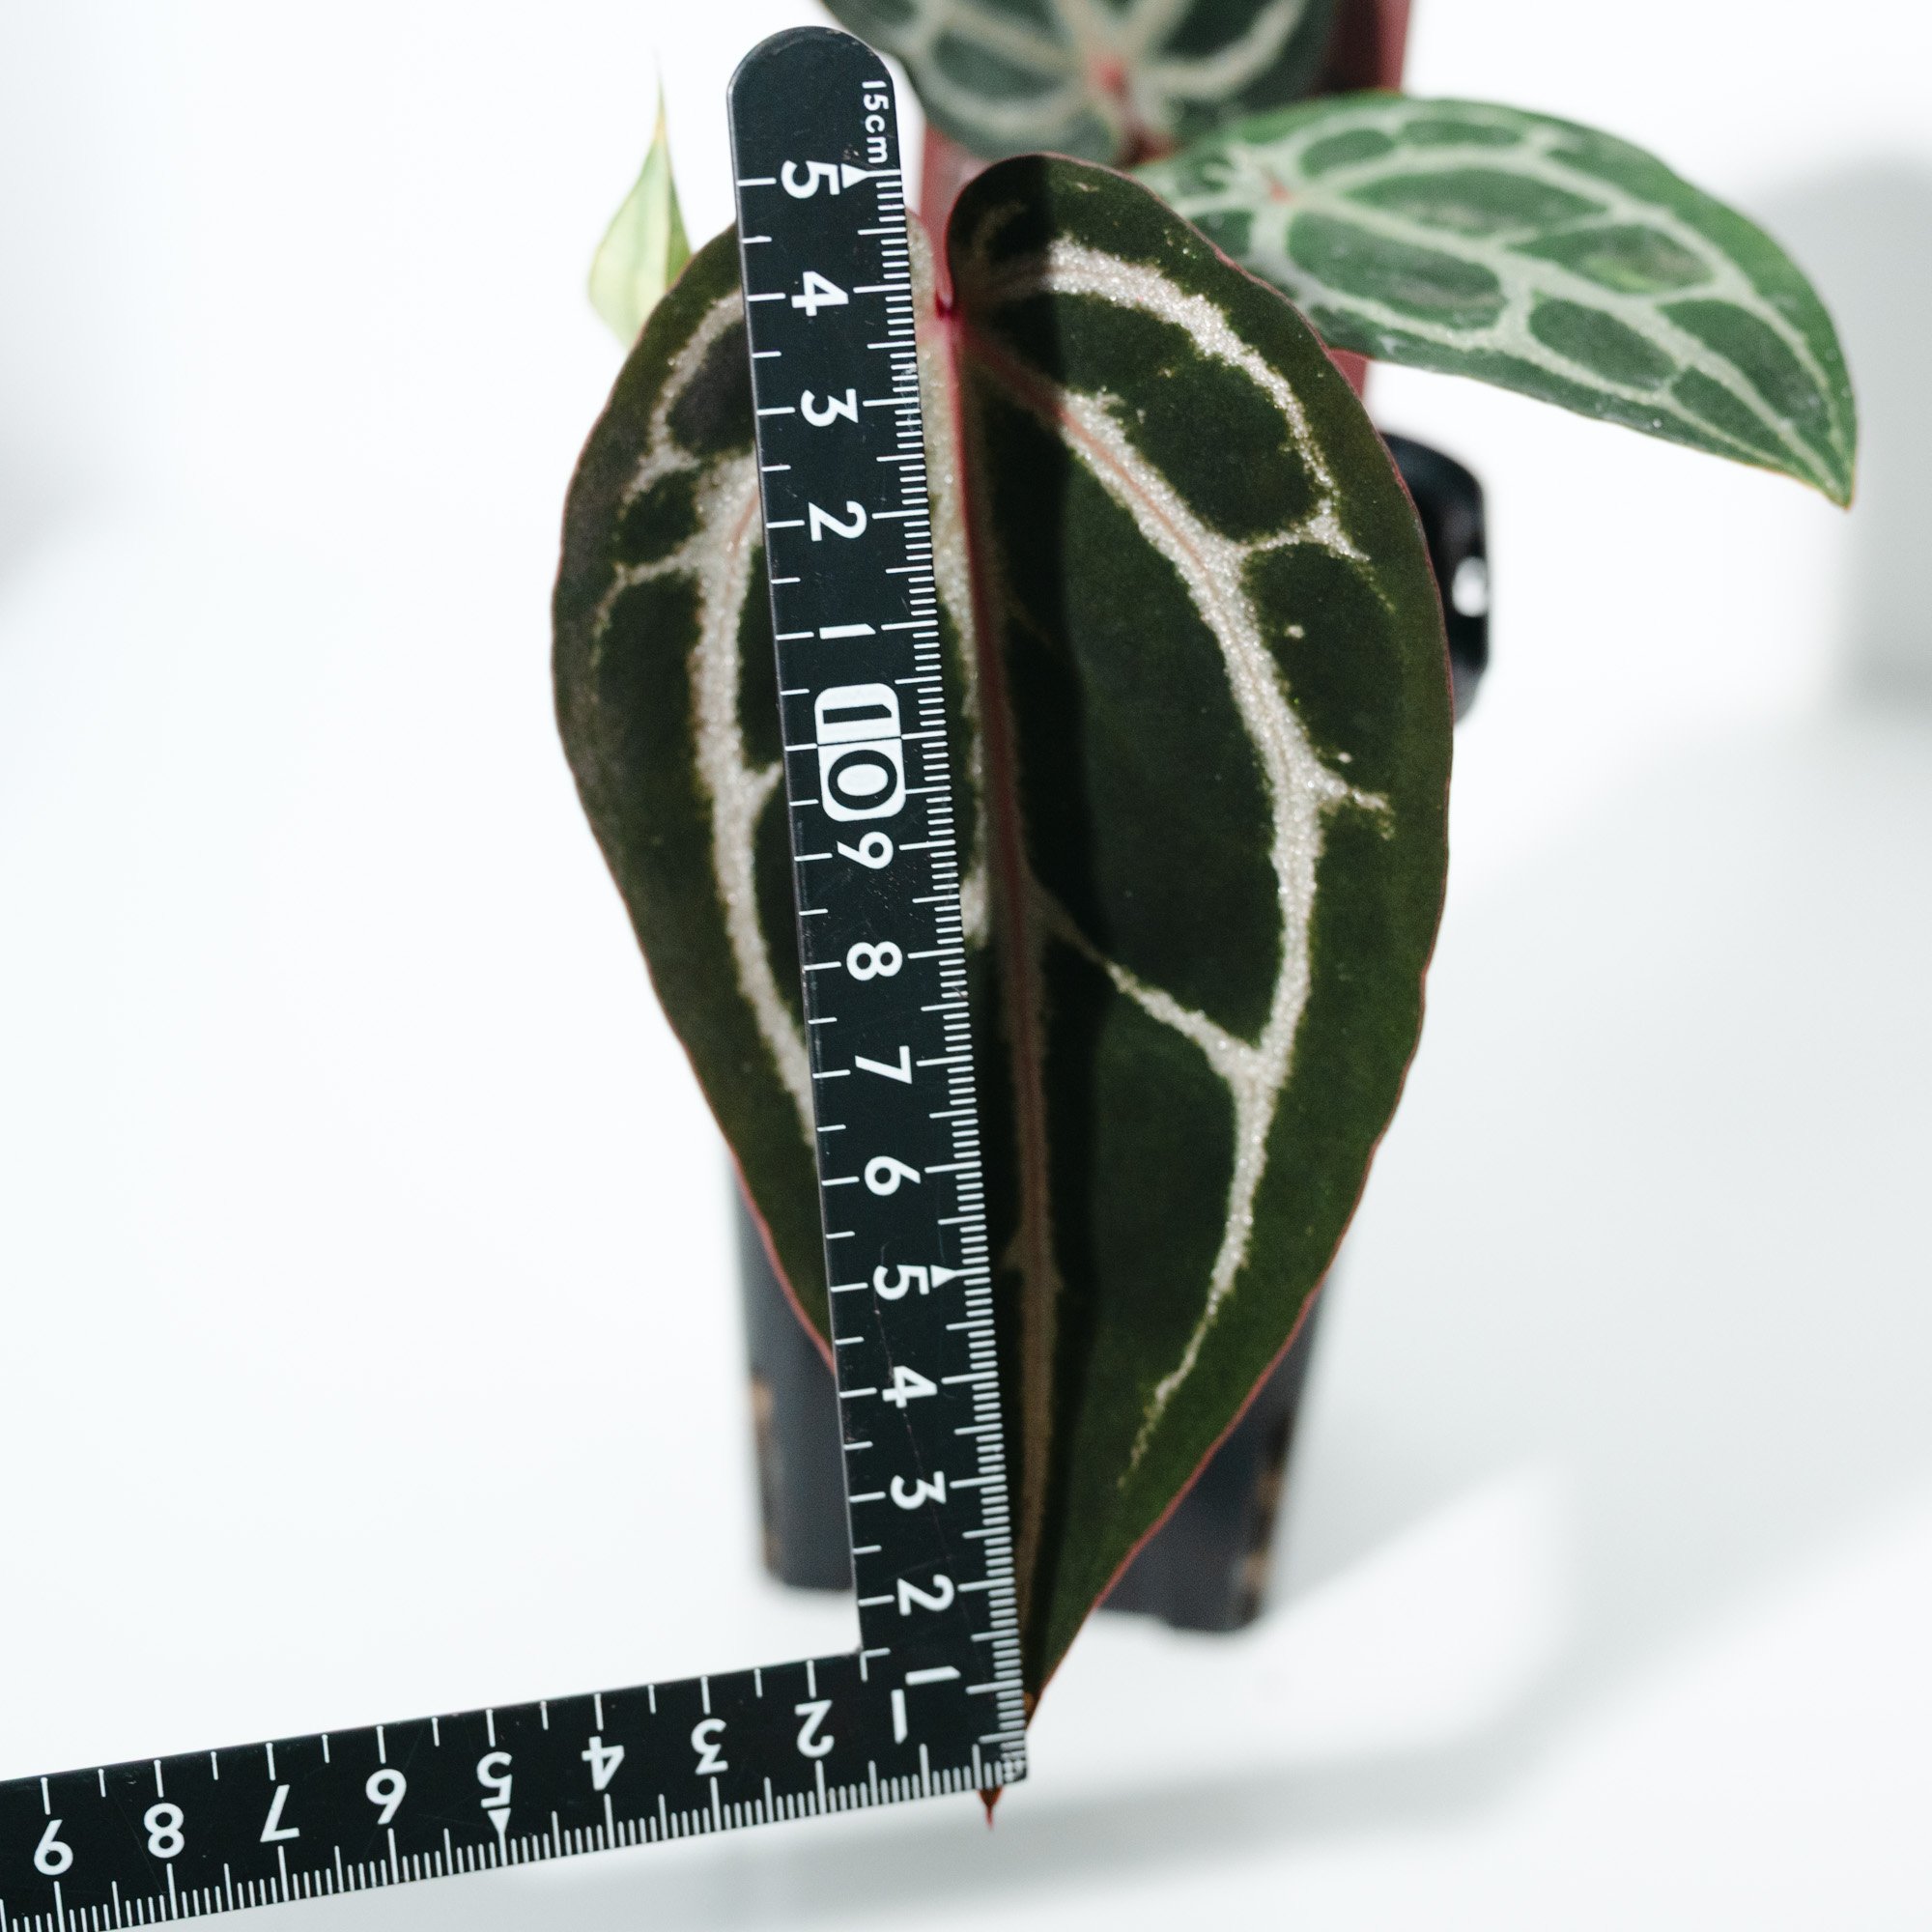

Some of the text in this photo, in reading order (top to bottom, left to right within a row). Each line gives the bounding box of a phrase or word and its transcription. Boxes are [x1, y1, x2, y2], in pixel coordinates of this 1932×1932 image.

[862, 80, 890, 164] 15cm
[781, 160, 840, 199] 5
[791, 270, 849, 317] 4
[800, 388, 859, 427] 3
[808, 500, 867, 542] 2
[818, 623, 876, 639] 1
[822, 702, 898, 811] 10
[837, 831, 894, 869] 9
[846, 941, 903, 981] 8
[854, 1045, 912, 1084] 7
[864, 1155, 921, 1196] 6
[872, 1264, 929, 1300] 5
[882, 1365, 938, 1408] 4
[890, 1471, 947, 1509] 3
[897, 1574, 954, 1615] 2
[905, 1666, 960, 1685] 1
[795, 1700, 834, 1757] 2
[891, 1689, 907, 1743] 1
[582, 1736, 625, 1790] 4
[691, 1719, 728, 1775] 3
[365, 1769, 407, 1825] 6
[476, 1751, 512, 1808] 5
[143, 1803, 185, 1859] 8
[260, 1784, 299, 1842] 7
[34, 1819, 73, 1876] 9
